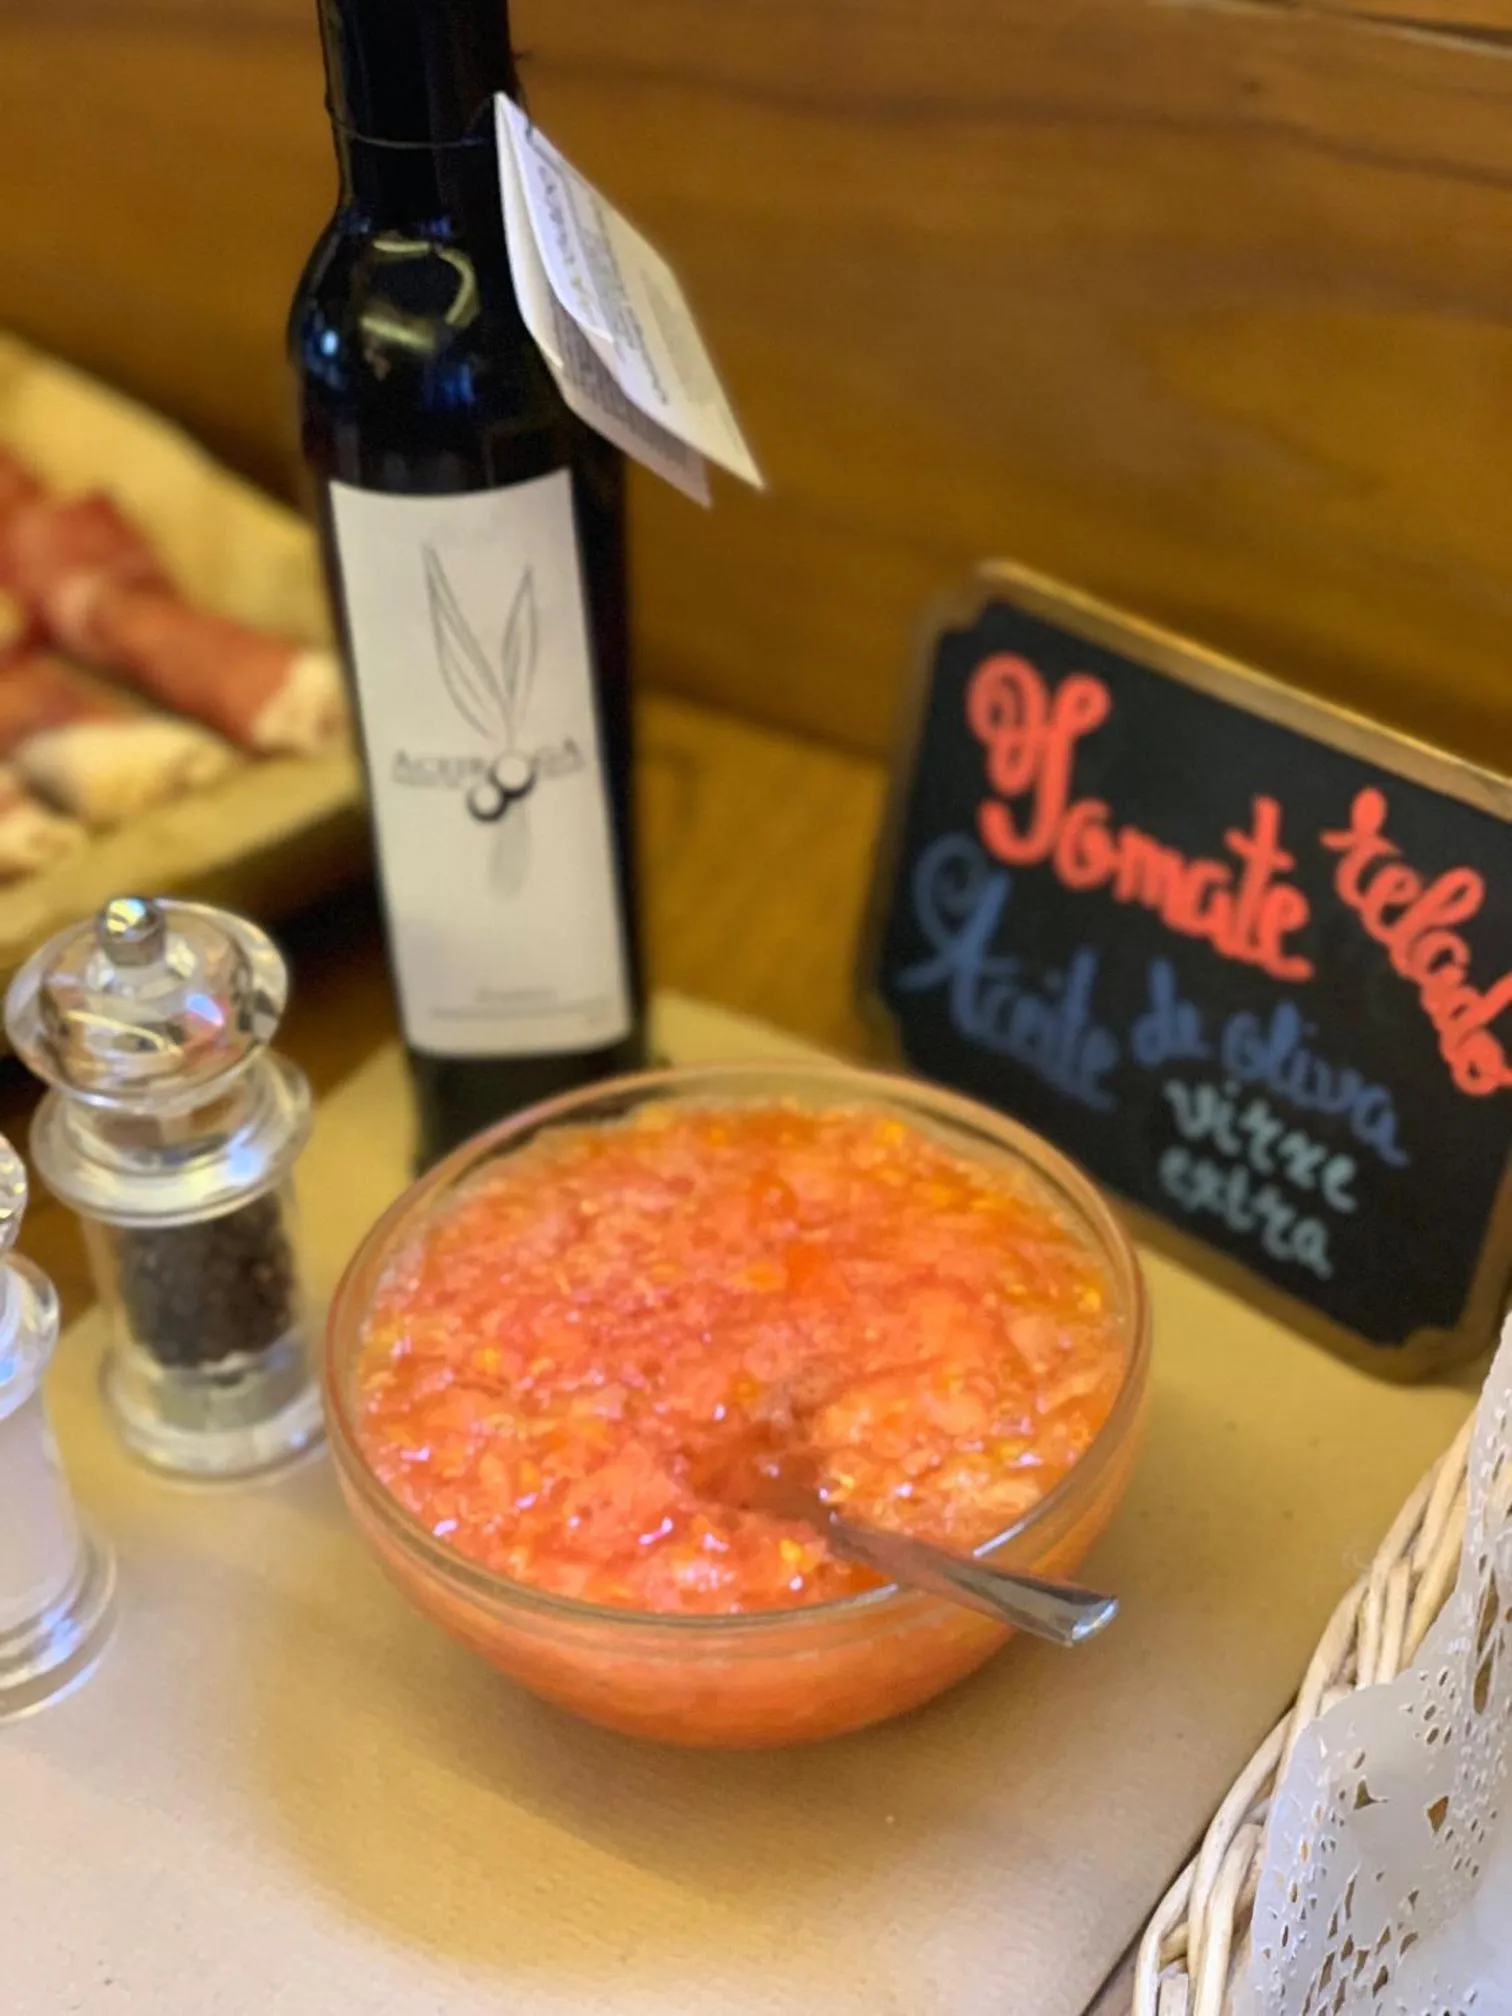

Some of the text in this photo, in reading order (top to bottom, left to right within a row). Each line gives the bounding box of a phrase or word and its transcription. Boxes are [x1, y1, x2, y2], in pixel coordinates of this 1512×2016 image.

[968, 654, 1311, 977] Tomate
[1223, 1003, 1408, 1166] oliva
[1160, 1149, 1333, 1279] extra
